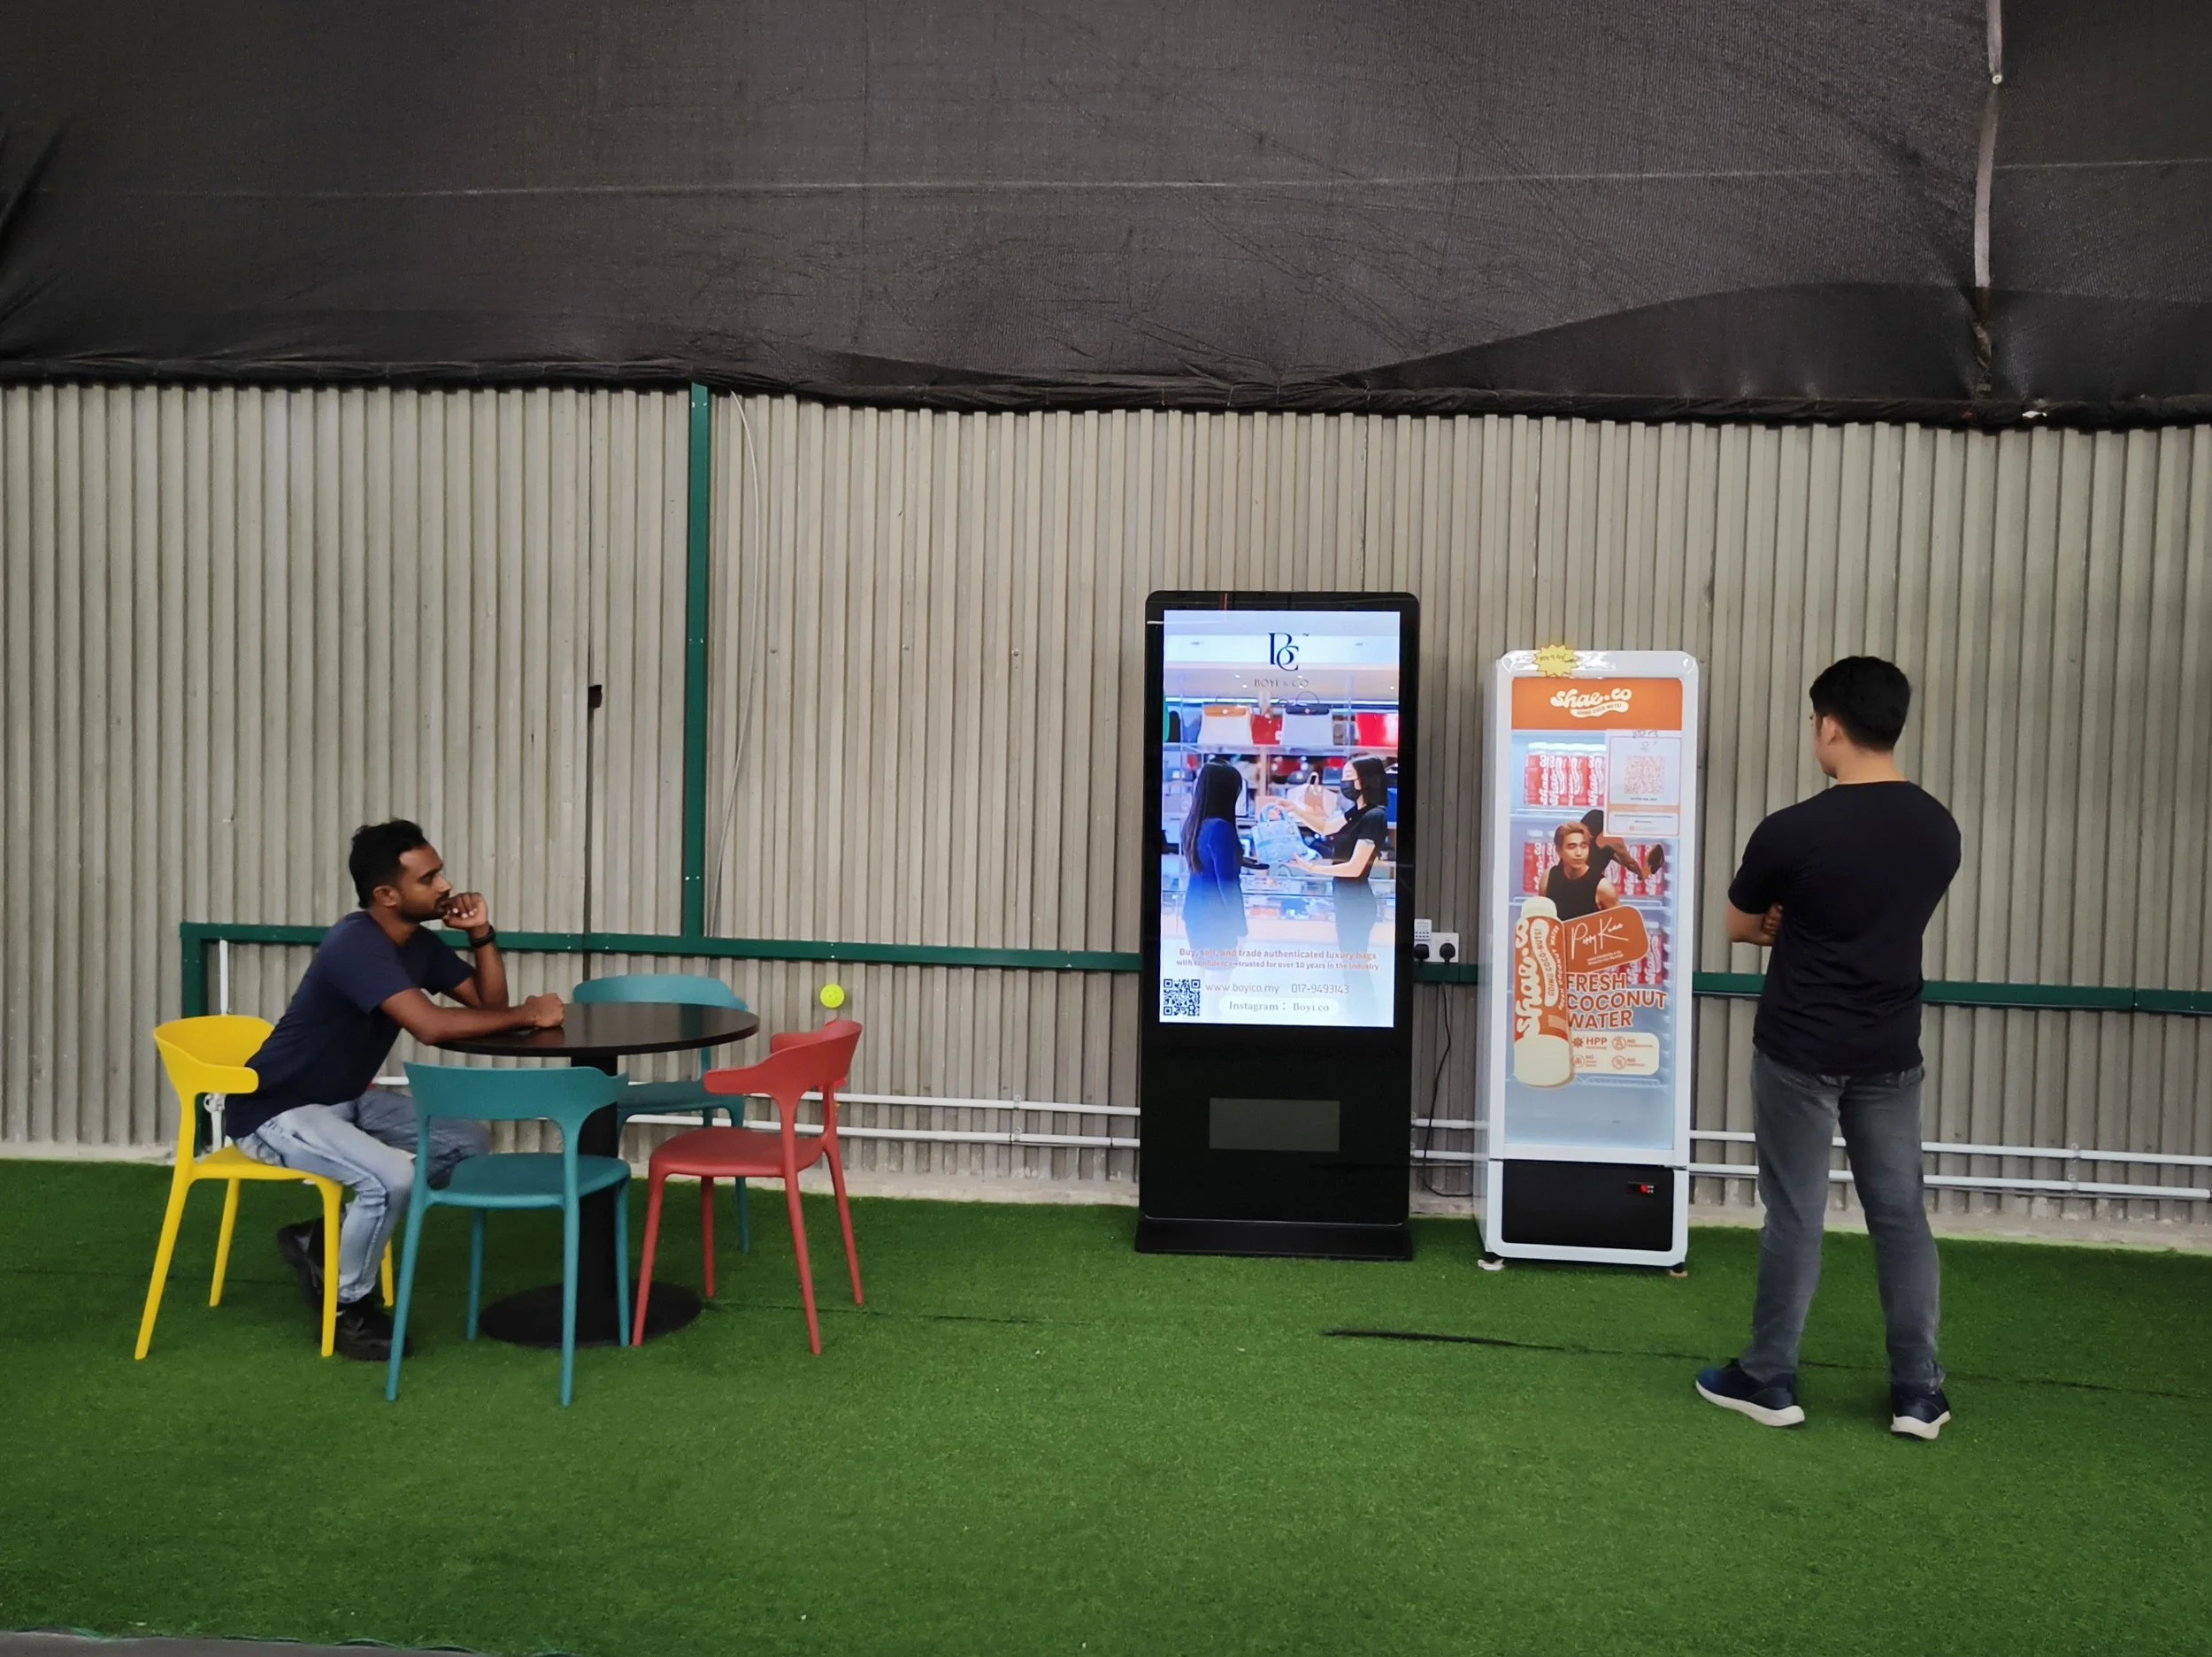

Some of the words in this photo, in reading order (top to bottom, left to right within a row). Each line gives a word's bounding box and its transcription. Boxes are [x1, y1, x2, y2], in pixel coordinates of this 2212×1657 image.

[1254, 679, 1279, 687] BOYI
[1292, 679, 1310, 688] CO
[1220, 948, 1237, 957] and
[1263, 950, 1325, 959] authenticated
[1326, 951, 1354, 961] luxury
[1356, 952, 1377, 961] bags
[1567, 973, 1625, 992] FRESH
[1293, 1001, 1329, 1013] Boyi.co
[1567, 990, 1667, 1011] COCONUT
[1568, 1010, 1632, 1029] WATER
[1586, 1036, 1608, 1046] HPP
